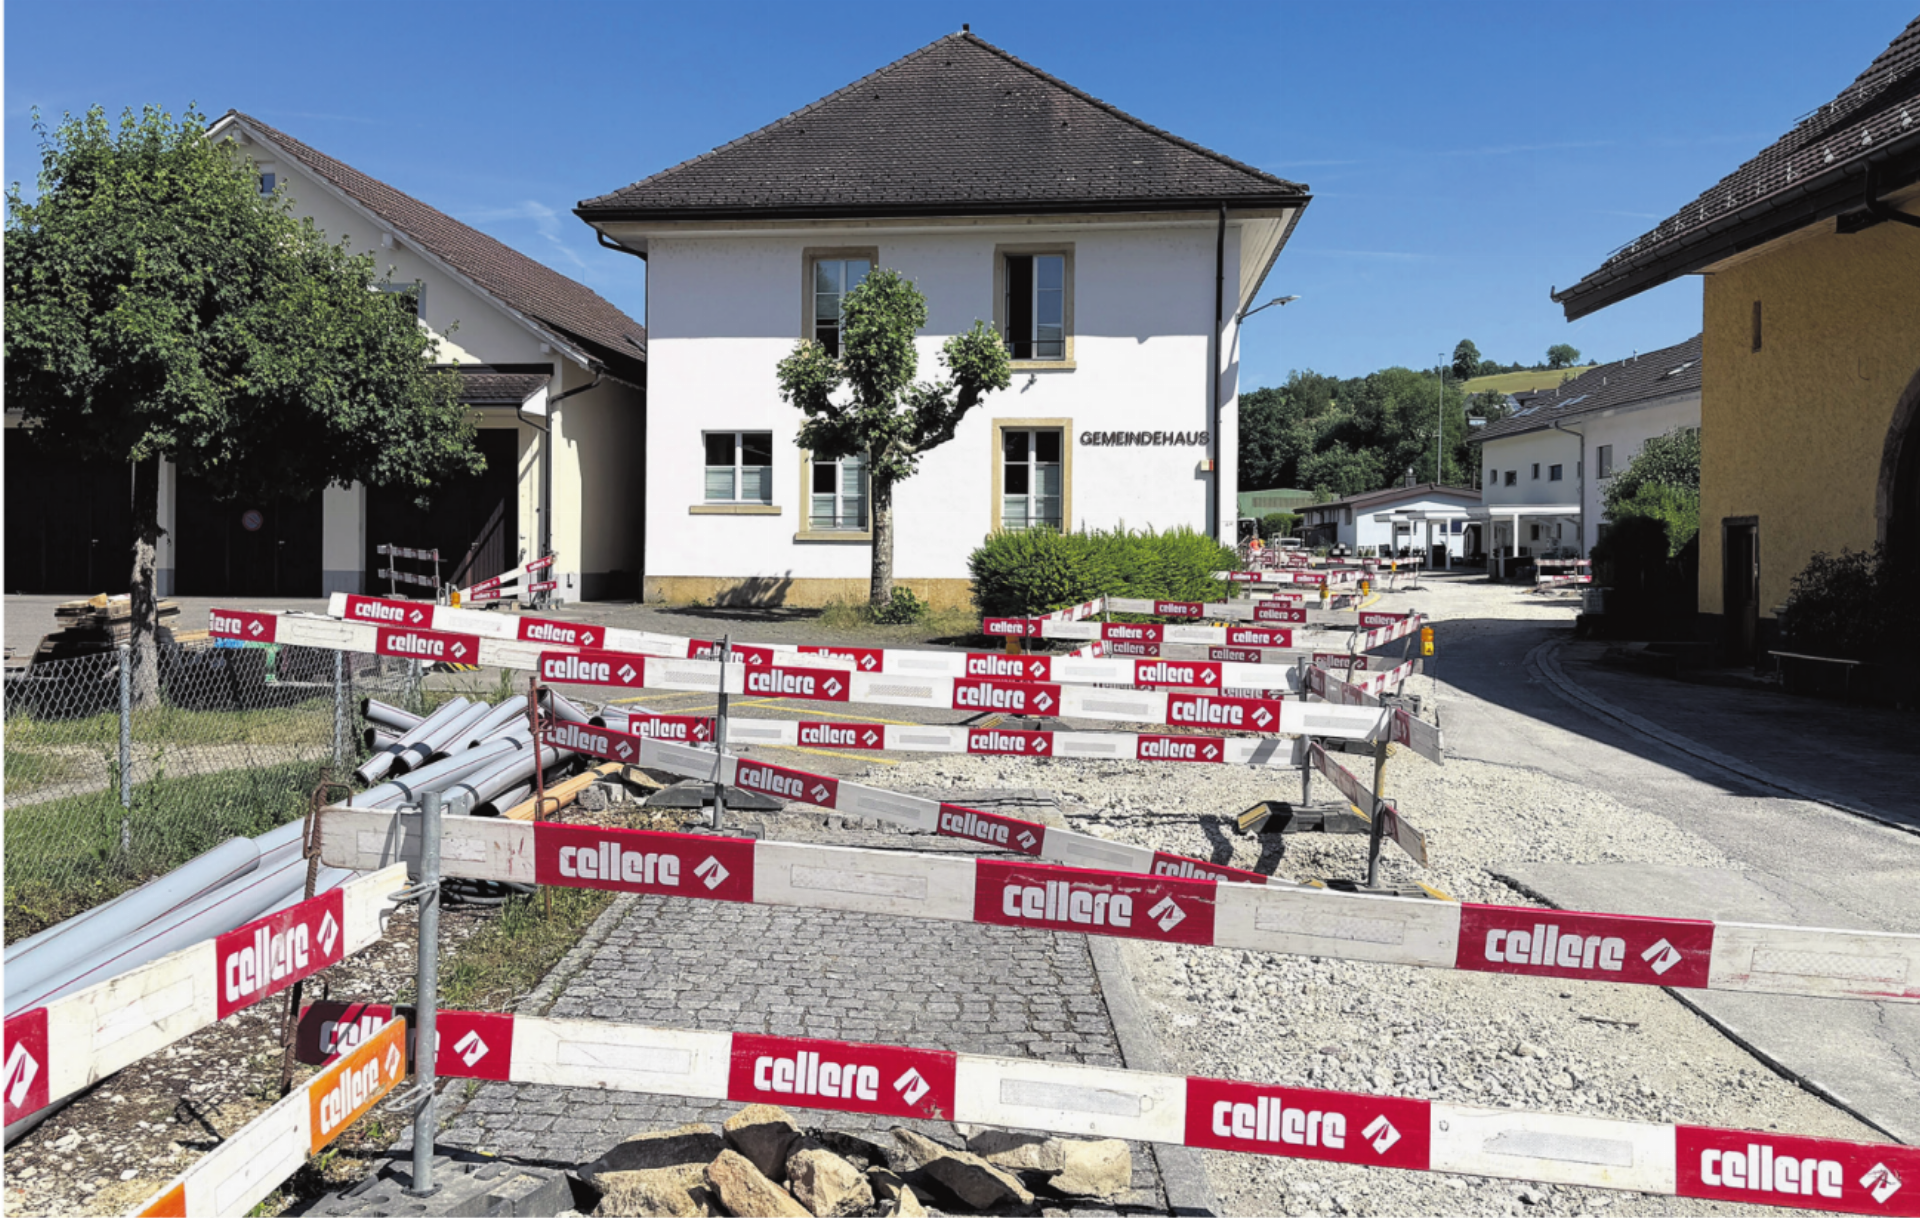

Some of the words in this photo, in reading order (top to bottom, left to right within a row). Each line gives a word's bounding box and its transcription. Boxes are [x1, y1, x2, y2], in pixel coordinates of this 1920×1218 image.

[1080, 431, 1210, 446] GEMEINDEHAUS
[354, 602, 404, 622] cellere
[1159, 602, 1187, 614] cellere
[1258, 608, 1288, 620] cellere
[527, 623, 576, 644] cellere
[990, 621, 1023, 634] cellere
[1108, 626, 1142, 638] cellere
[1233, 631, 1270, 644] cellere
[387, 634, 444, 656] cellere
[1113, 642, 1146, 654] cellere
[1212, 649, 1245, 661] cellere
[544, 656, 610, 681] cellere
[968, 655, 1023, 676] cellere
[1138, 662, 1194, 683] cellere
[748, 669, 815, 694] cellere
[956, 682, 1026, 710] cellere
[1172, 696, 1244, 727] cellere
[631, 718, 686, 738] cellere
[801, 724, 856, 744] cellere
[546, 724, 608, 754] cellere
[970, 733, 1025, 752] cellere
[1140, 738, 1196, 758] cellere
[738, 765, 804, 798] cellere
[940, 811, 1009, 844] cellere
[560, 841, 681, 886] cellere
[1002, 880, 1133, 928] cellere
[1485, 923, 1626, 971] cellere
[225, 922, 309, 1003] cellere
[754, 1050, 879, 1101] cellere
[320, 1057, 379, 1136] cellere
[1212, 1095, 1346, 1150] cellere
[1700, 1144, 1843, 1200] cellere
